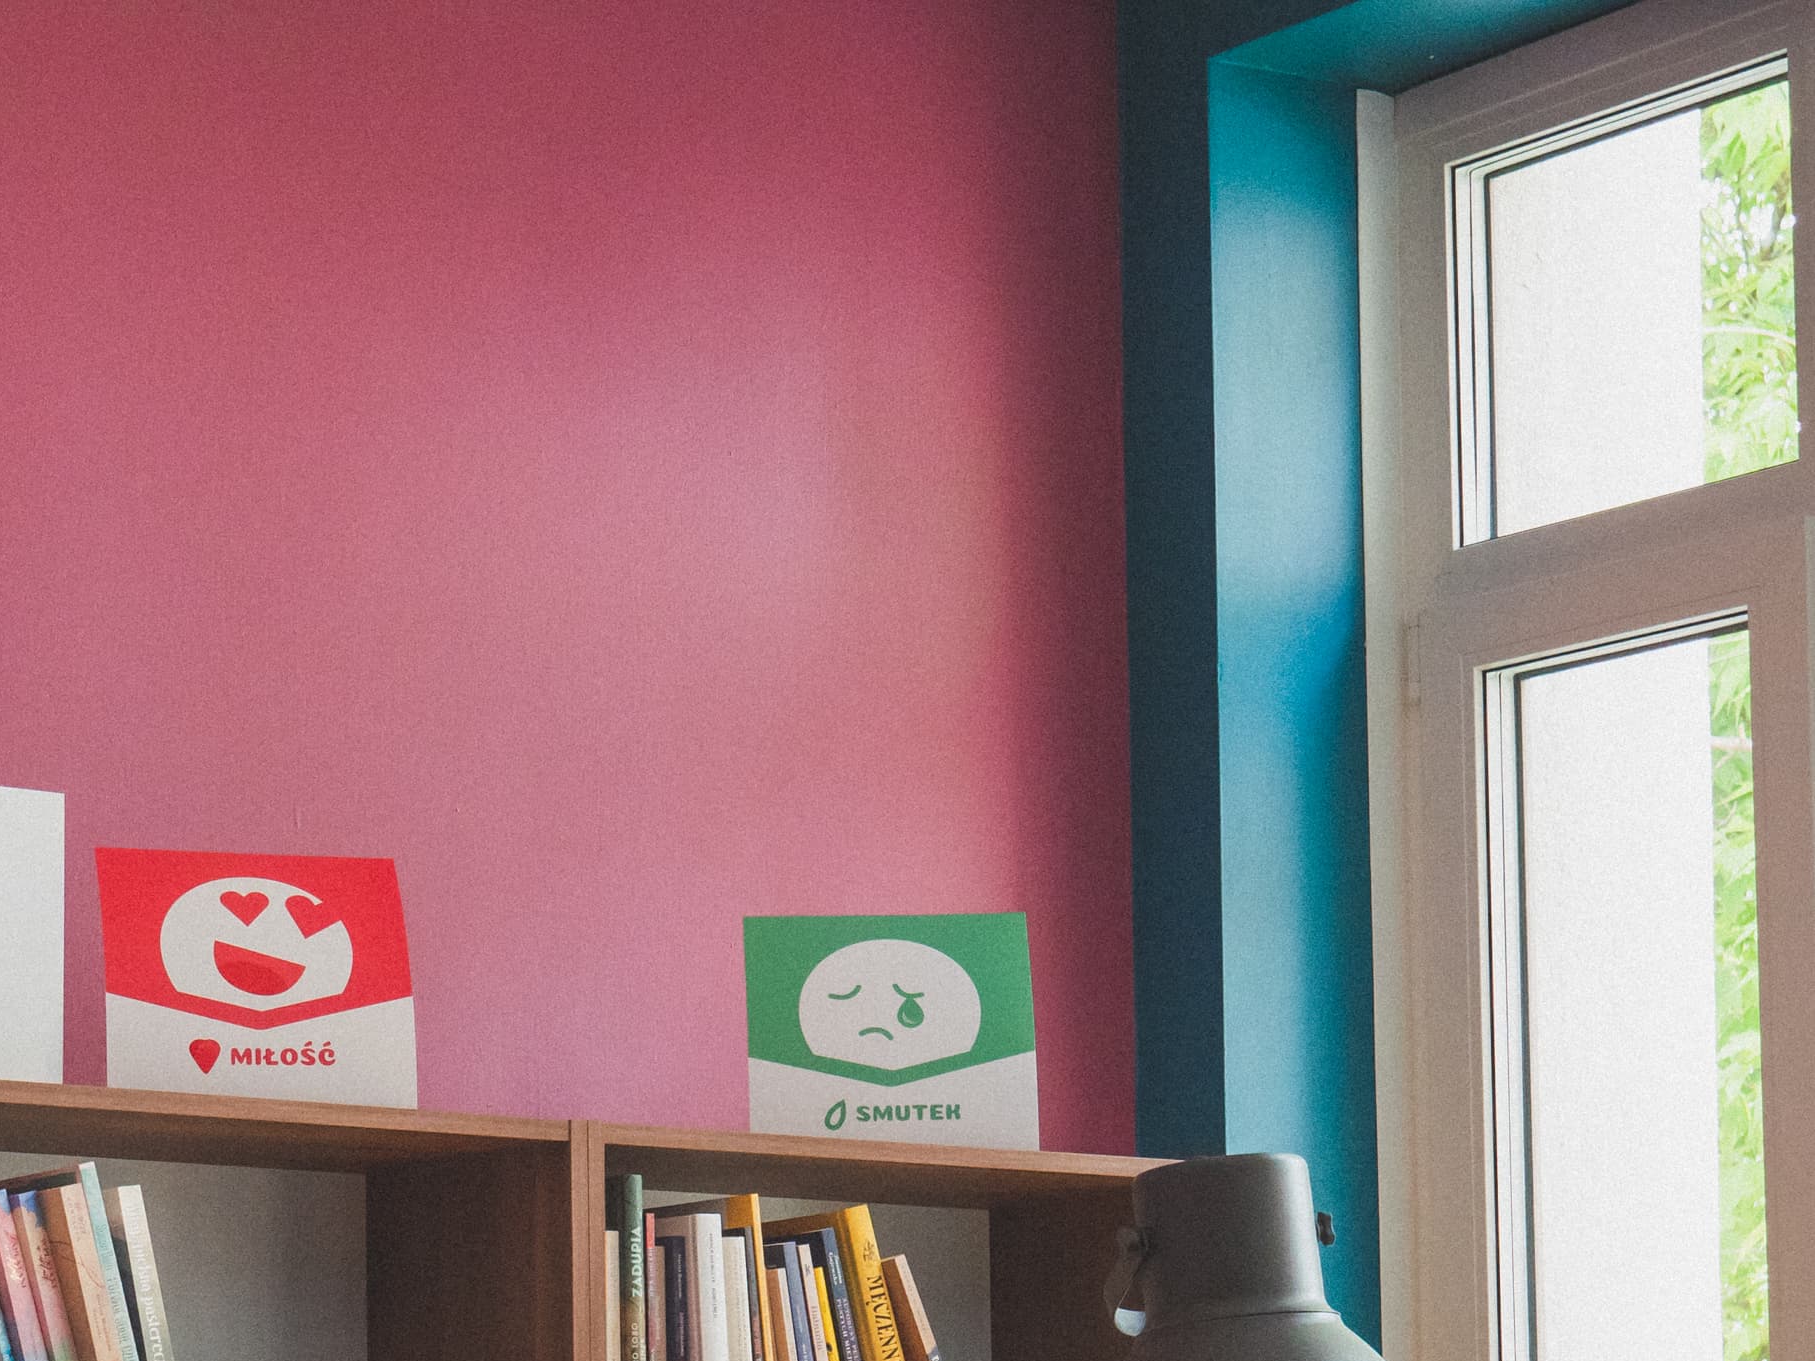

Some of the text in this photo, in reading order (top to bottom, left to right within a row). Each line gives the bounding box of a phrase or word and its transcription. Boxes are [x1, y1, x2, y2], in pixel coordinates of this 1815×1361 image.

[231, 1041, 336, 1066] MIŁOŚĆ
[856, 1104, 961, 1121] SMUTEK
[631, 1225, 643, 1298] ZADUPIA
